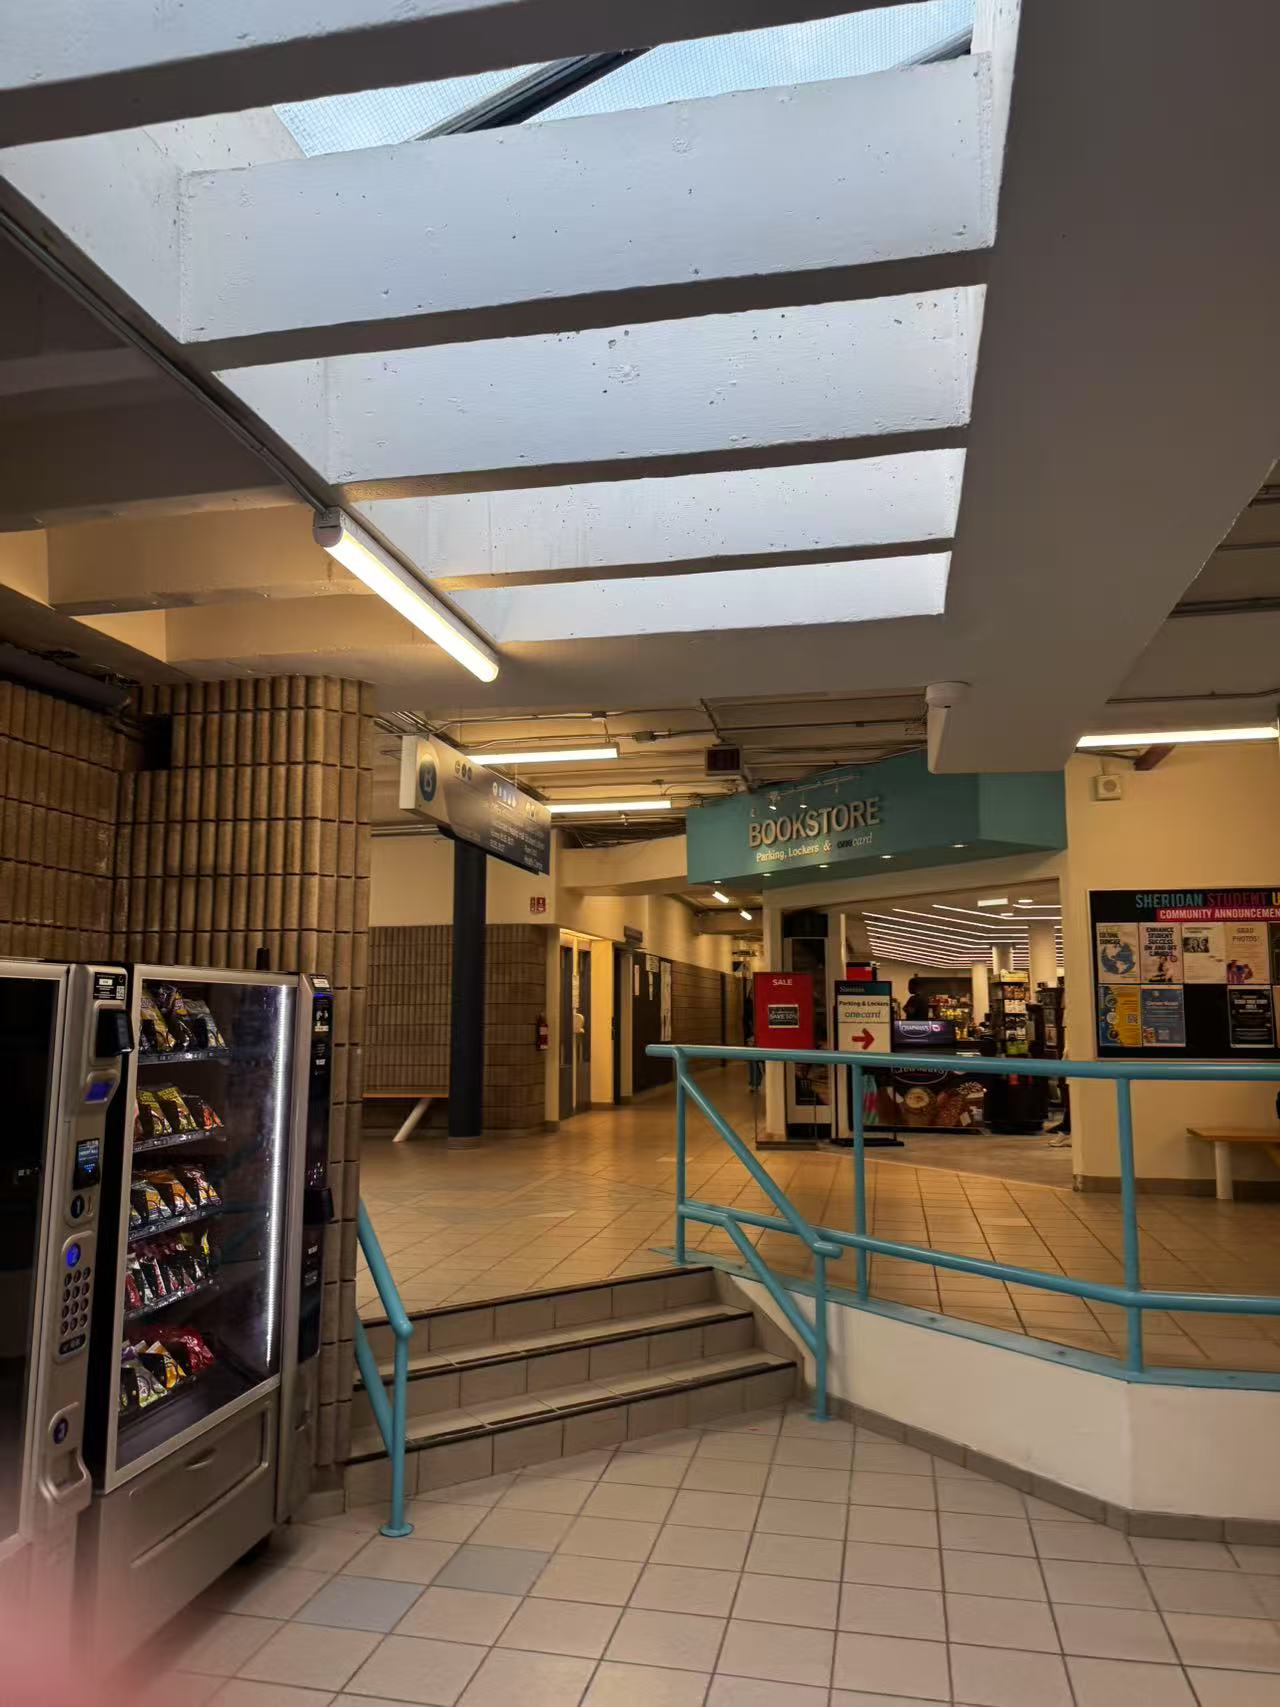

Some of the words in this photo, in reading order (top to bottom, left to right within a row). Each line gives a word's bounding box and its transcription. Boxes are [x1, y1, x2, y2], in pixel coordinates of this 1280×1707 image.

[748, 797, 881, 848] BOOKSTORE
[756, 849, 788, 862] Parking,
[788, 844, 820, 857] Lockers
[823, 841, 833, 852] &
[1135, 893, 1203, 909] SHERIDAN
[1207, 891, 1269, 908] STUDENT
[1160, 908, 1212, 919] COMMUNITY
[839, 1000, 860, 1008] Parking
[844, 1010, 880, 1019] onecard
